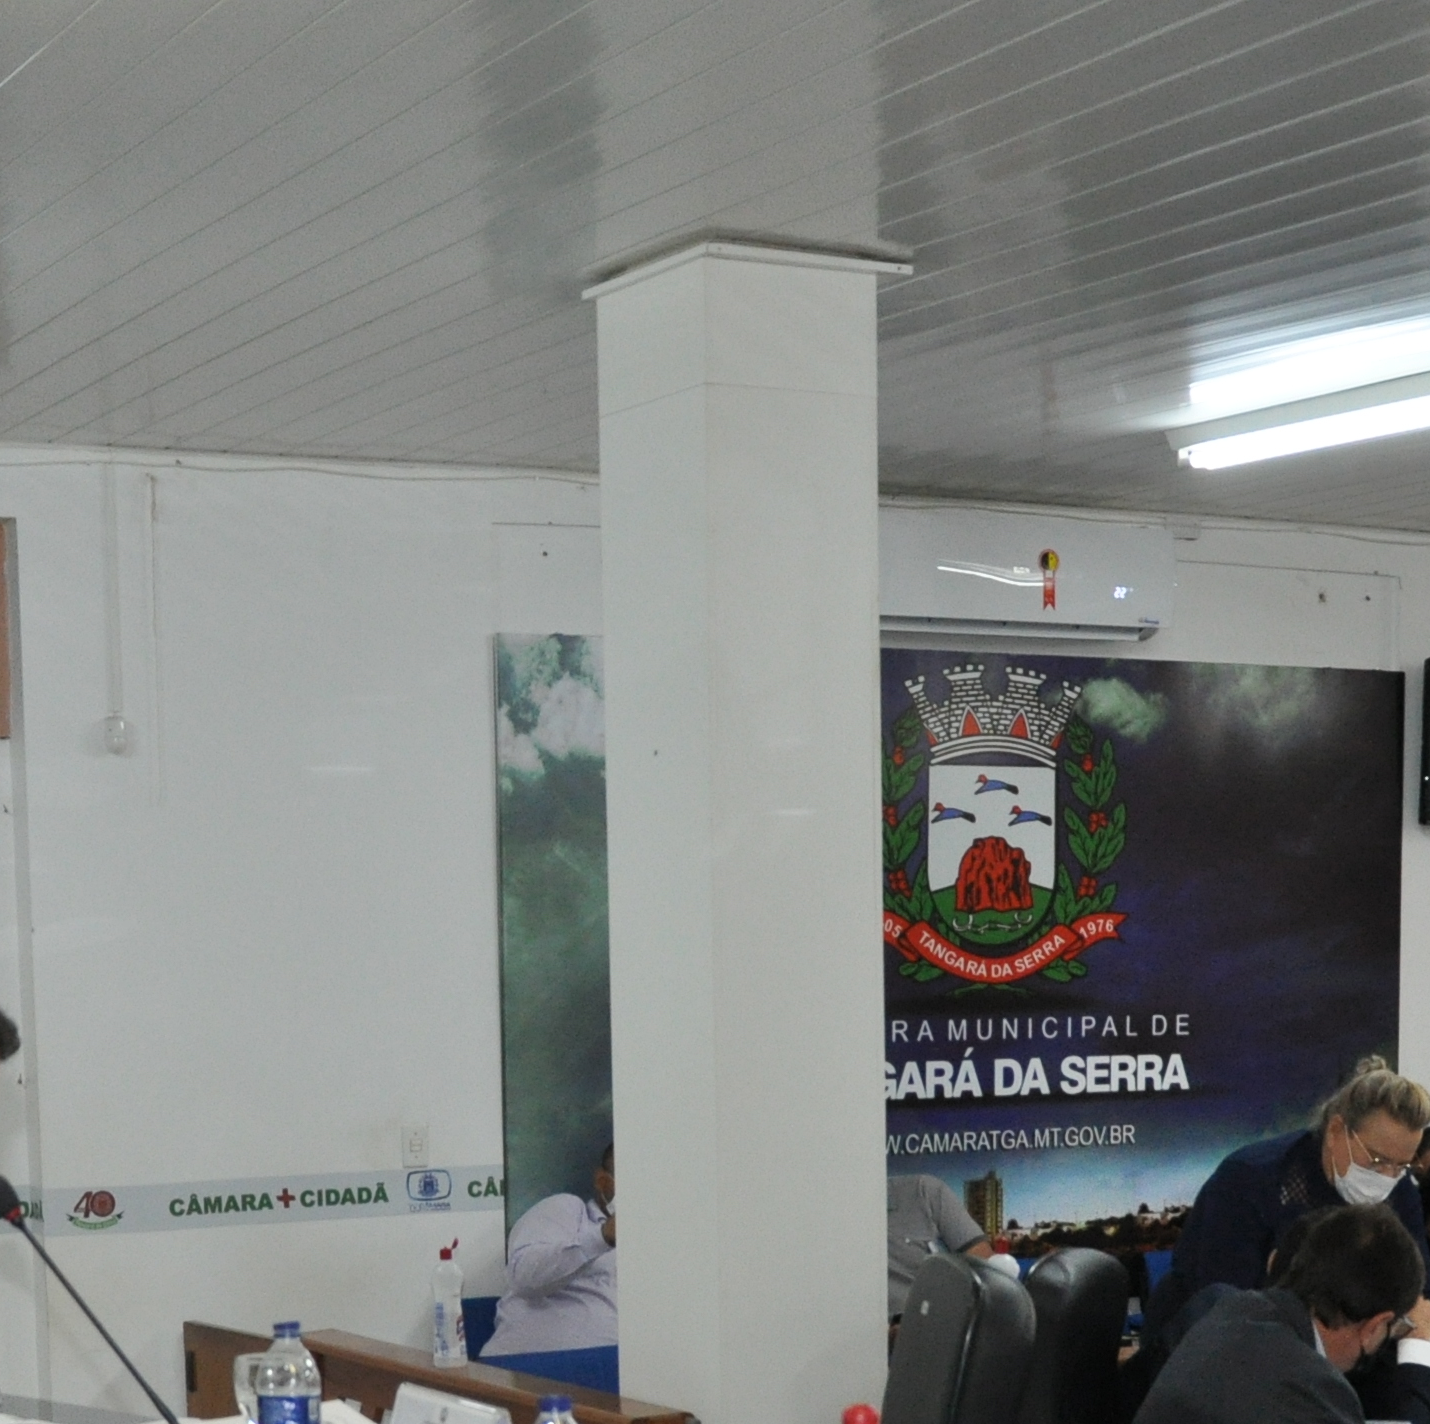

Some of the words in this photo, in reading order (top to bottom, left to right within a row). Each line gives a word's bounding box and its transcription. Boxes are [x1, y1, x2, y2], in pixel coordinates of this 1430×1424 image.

[1078, 918, 1114, 940] 1976
[918, 930, 988, 978] TANGARÁ
[991, 963, 1014, 978] DA
[1015, 933, 1066, 973] SERRA
[947, 1016, 1139, 1041] MUNICIPAL
[1151, 1014, 1191, 1036] DE
[993, 1057, 1051, 1097] DA
[1059, 1053, 1191, 1095] SERRA
[467, 1178, 504, 1199] CÂ
